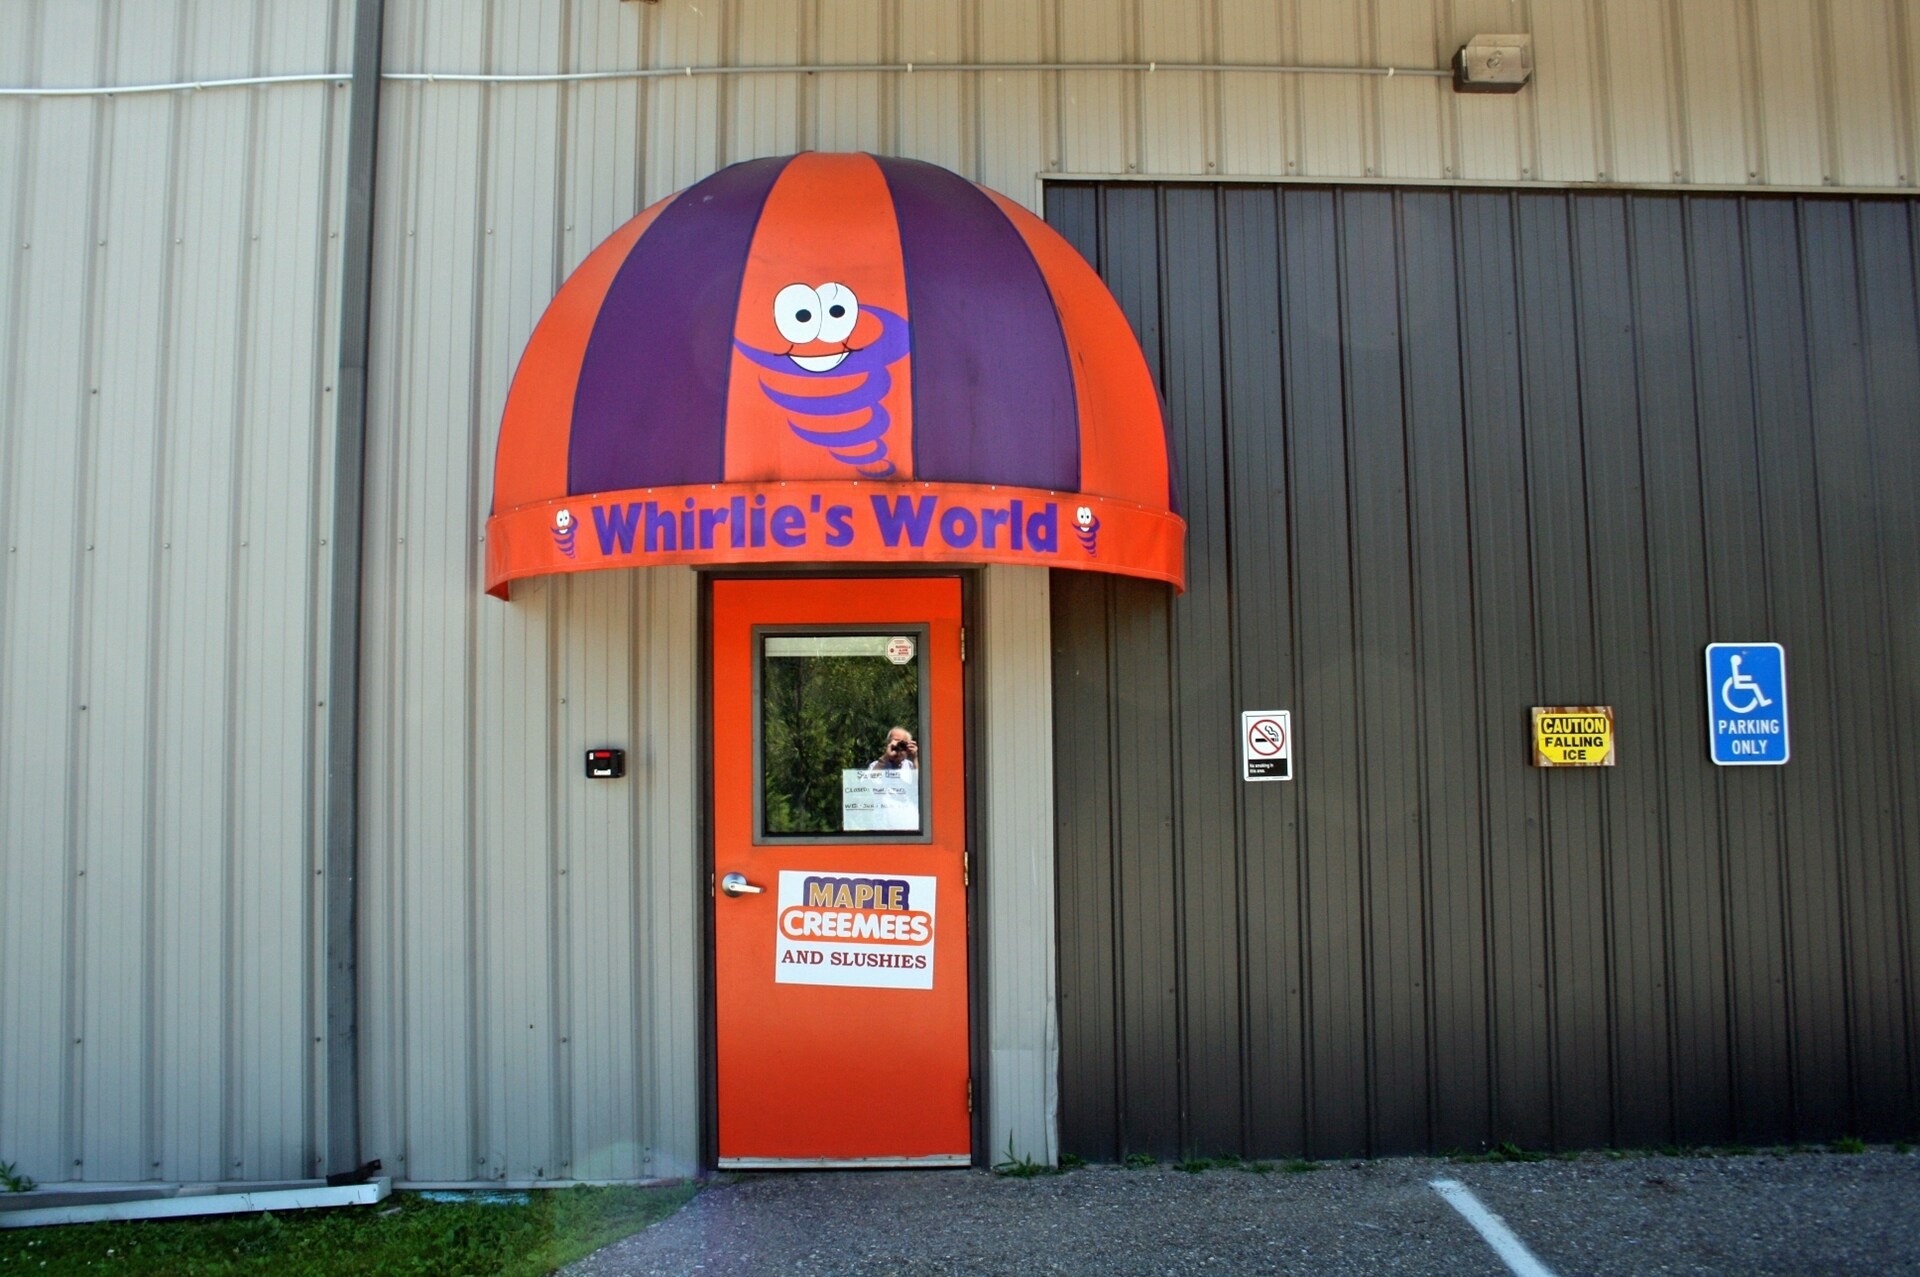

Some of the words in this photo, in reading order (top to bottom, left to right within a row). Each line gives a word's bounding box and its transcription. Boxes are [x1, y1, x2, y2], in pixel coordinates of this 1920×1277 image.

[591, 493, 854, 556] Whirlie's
[869, 494, 1058, 553] World
[1543, 718, 1605, 733] CAUTION
[1718, 719, 1780, 734] PARKING
[1545, 737, 1604, 747] FALLING
[1732, 740, 1767, 754] ONLY
[1563, 750, 1587, 760] ICE
[809, 882, 904, 910] MAPLE
[783, 909, 929, 942] CREEMEES
[781, 950, 824, 965] AND
[830, 951, 927, 969] SLUSHIES
